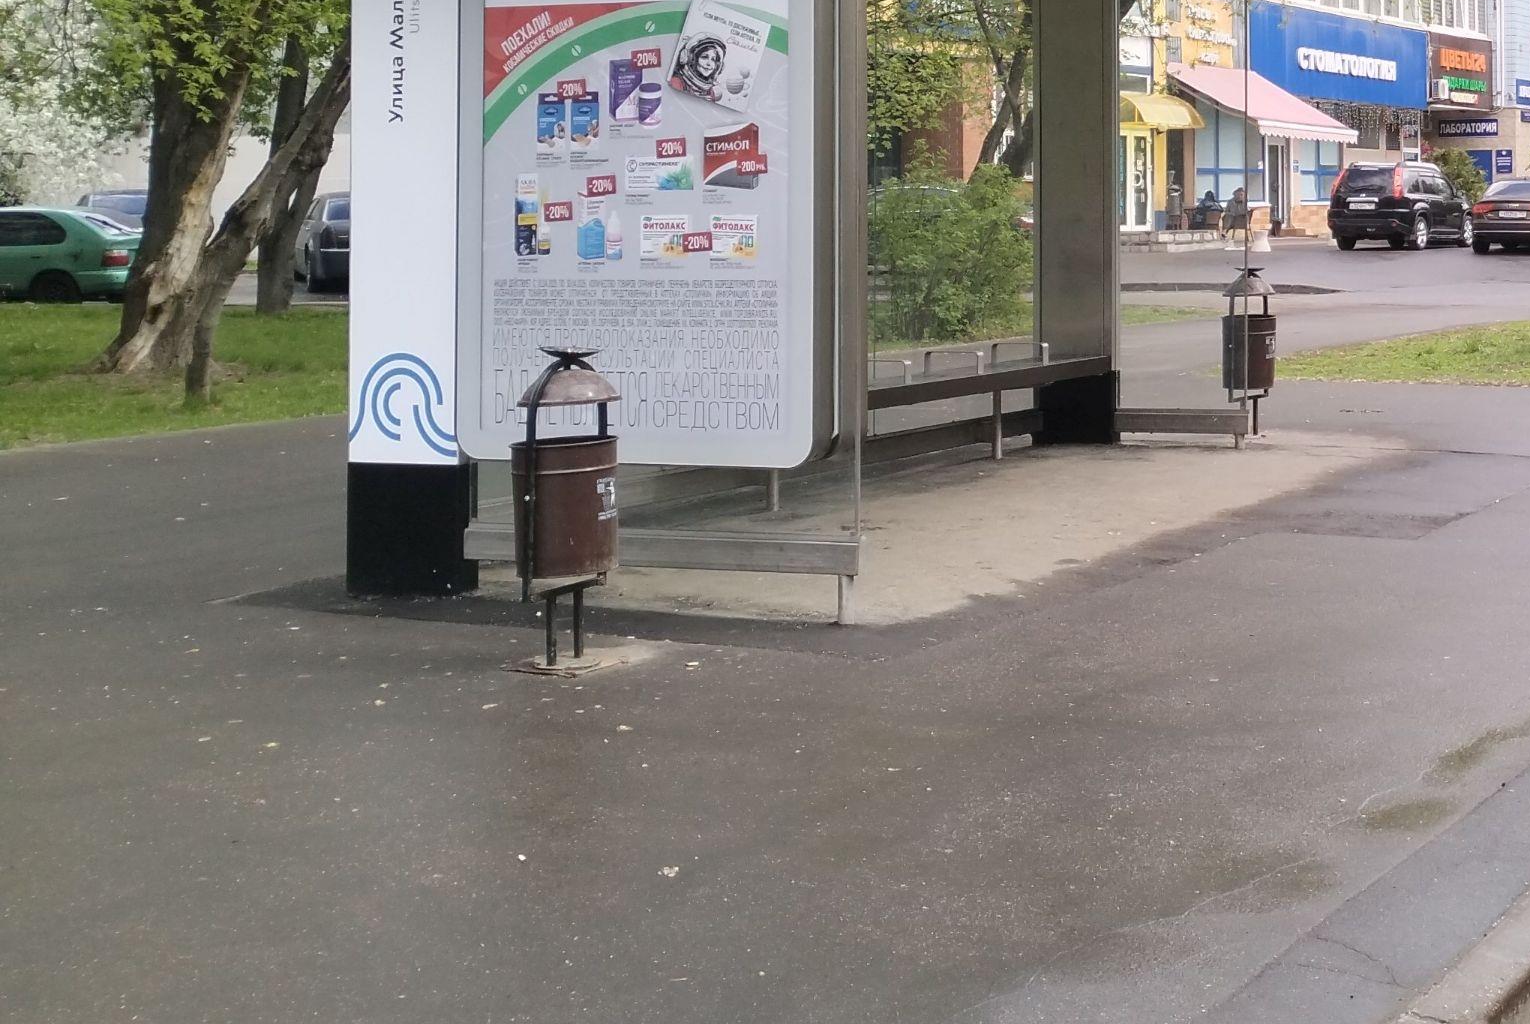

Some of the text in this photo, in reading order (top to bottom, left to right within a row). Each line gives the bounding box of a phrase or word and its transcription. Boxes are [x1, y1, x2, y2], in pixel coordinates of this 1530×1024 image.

[501, 10, 551, 56] ПОЕХАЛИ!
[502, 16, 575, 74] КОСМИЧЕСКИЕ СКИДКИ
[633, 52, 658, 67] -20%
[1297, 46, 1397, 82] СТОМАТОЛОГИЯ
[388, 56, 405, 123] Улица
[559, 83, 583, 97] -20%
[1440, 122, 1497, 134] ЛАБОРАТОРИЯ
[658, 140, 683, 156] -20%
[705, 139, 750, 153] СТИМОЛ
[738, 160, 755, 172] -200
[588, 179, 612, 193] -20%
[546, 205, 570, 219] -20%
[642, 222, 686, 230] ФИТОЛАКС
[712, 222, 754, 231] ФИТОЛАКС
[684, 235, 709, 249] -20%
[492, 327, 551, 347] ИМЕЮТСЯ
[691, 330, 779, 351] НЕОБХОДИМО
[684, 350, 780, 373] СПЕЦИАЛИСТА
[653, 372, 779, 400] ЛЕКАРСТВЕННЫМ
[652, 400, 779, 432] СРЕДСТВОМ
